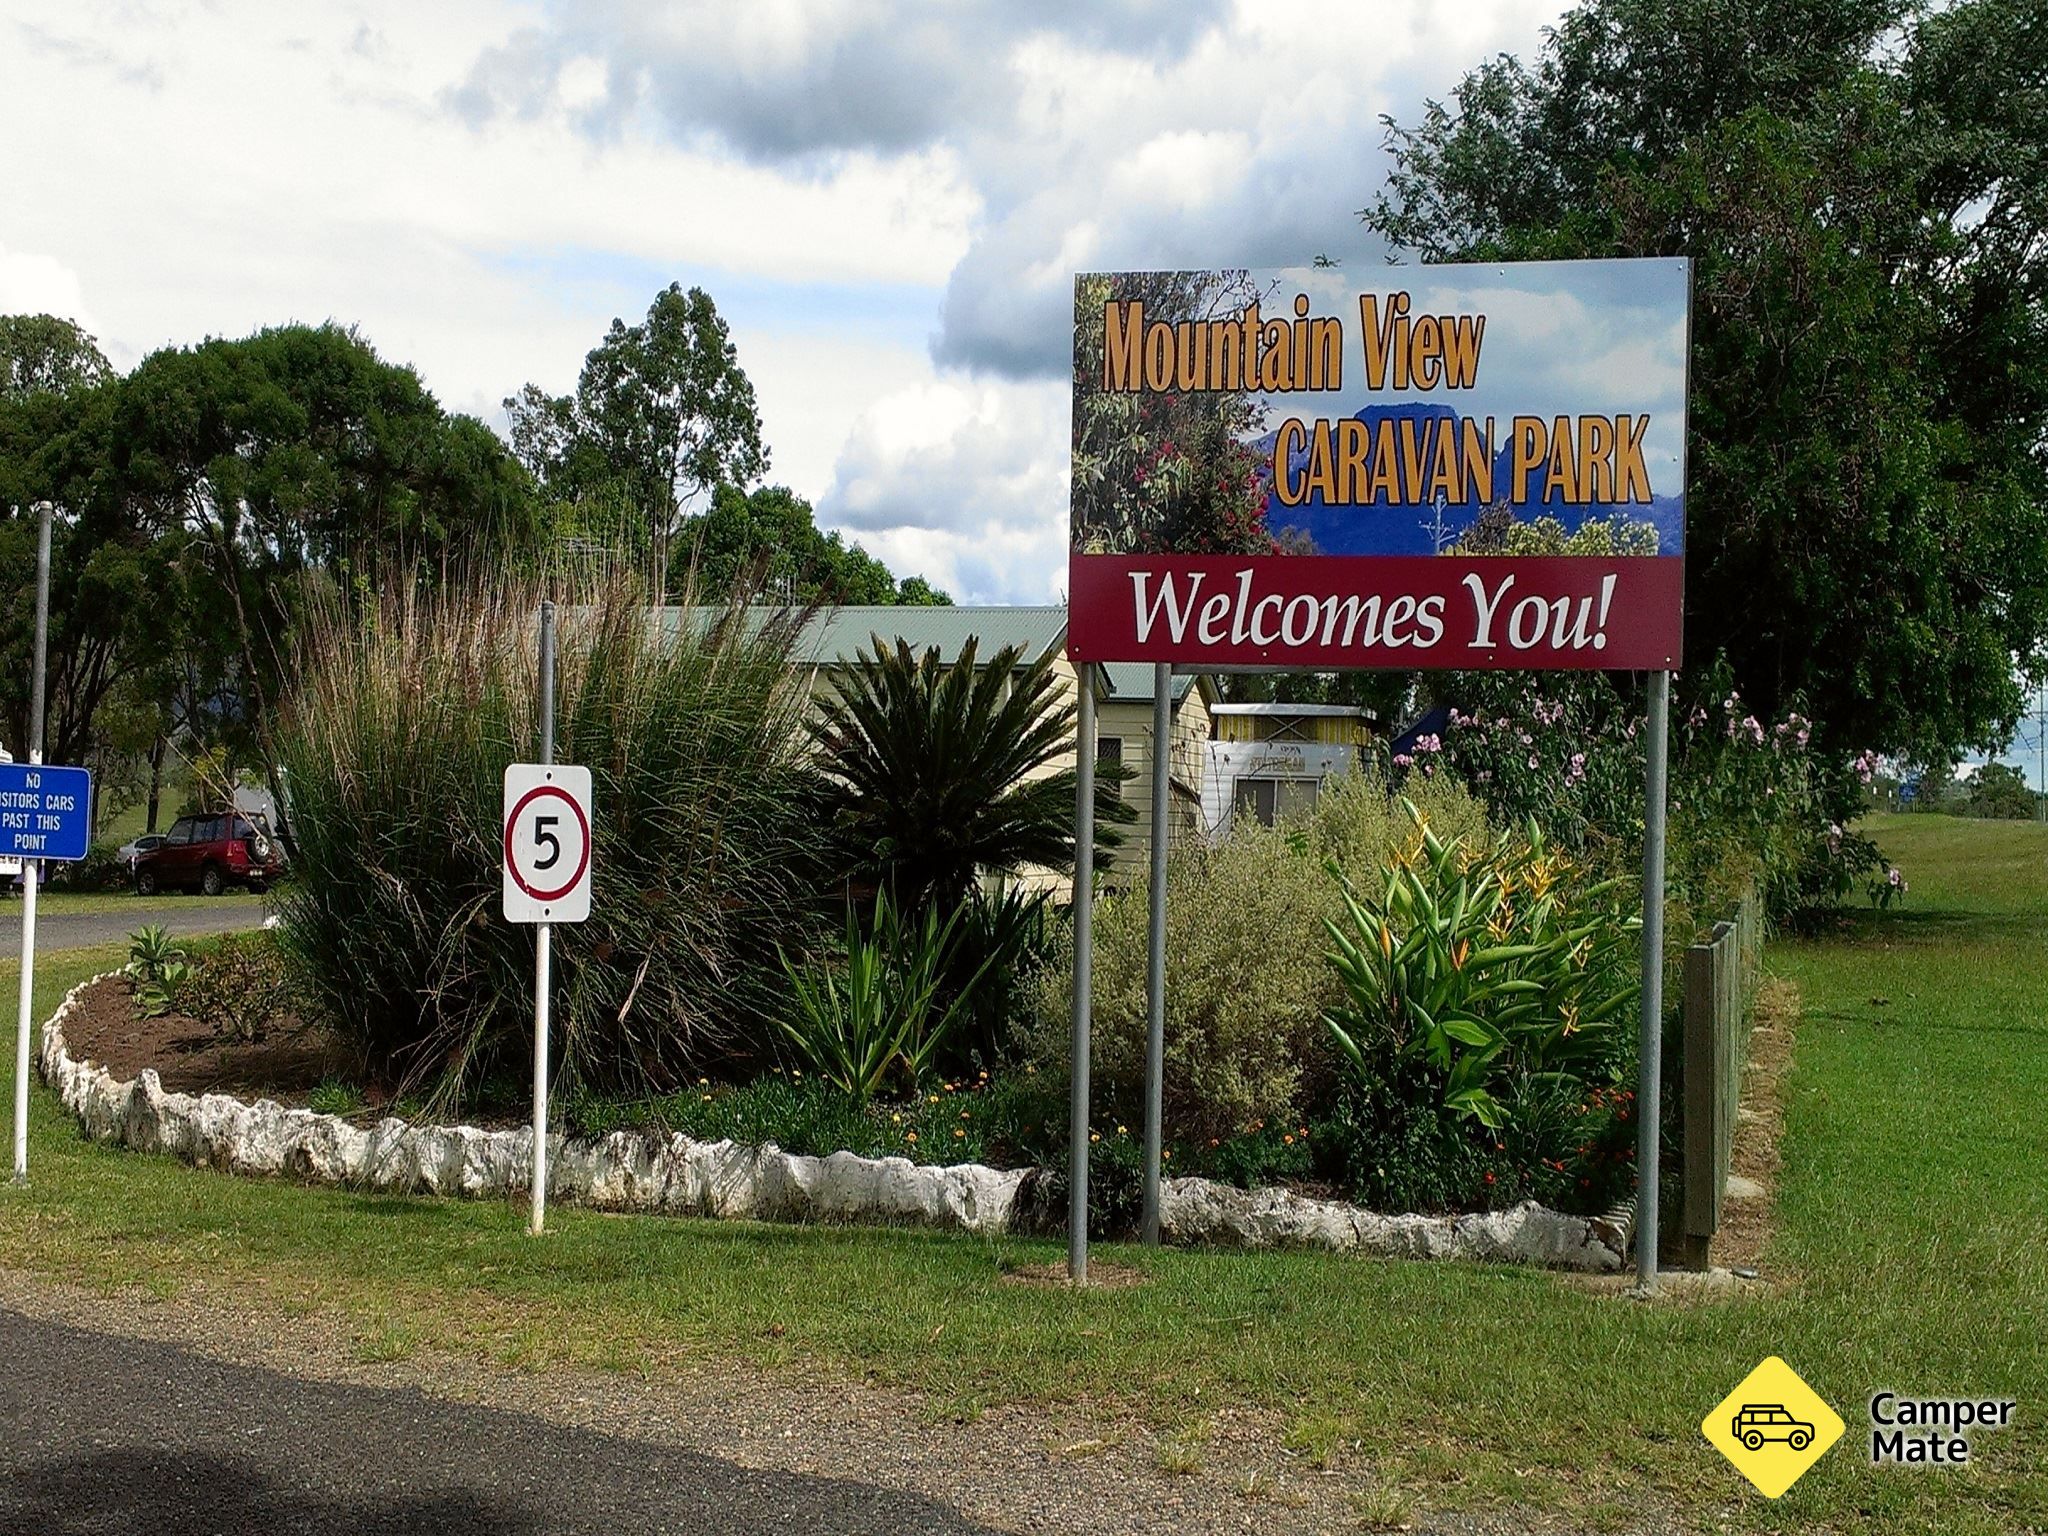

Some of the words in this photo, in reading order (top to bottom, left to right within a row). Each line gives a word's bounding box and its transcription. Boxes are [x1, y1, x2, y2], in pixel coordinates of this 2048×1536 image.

[1103, 292, 1343, 393] Mountain
[1359, 291, 1486, 392] View
[1274, 416, 1494, 507] CARAVAN
[1511, 415, 1653, 506] PARK
[1128, 568, 1446, 649] Welcomes
[1462, 572, 1618, 651] You!
[26, 773, 41, 788] NO
[2, 812, 30, 828] PAST
[36, 814, 61, 830] THIS
[45, 794, 75, 812] CARS
[14, 833, 47, 850] POINT
[533, 816, 560, 870] 5
